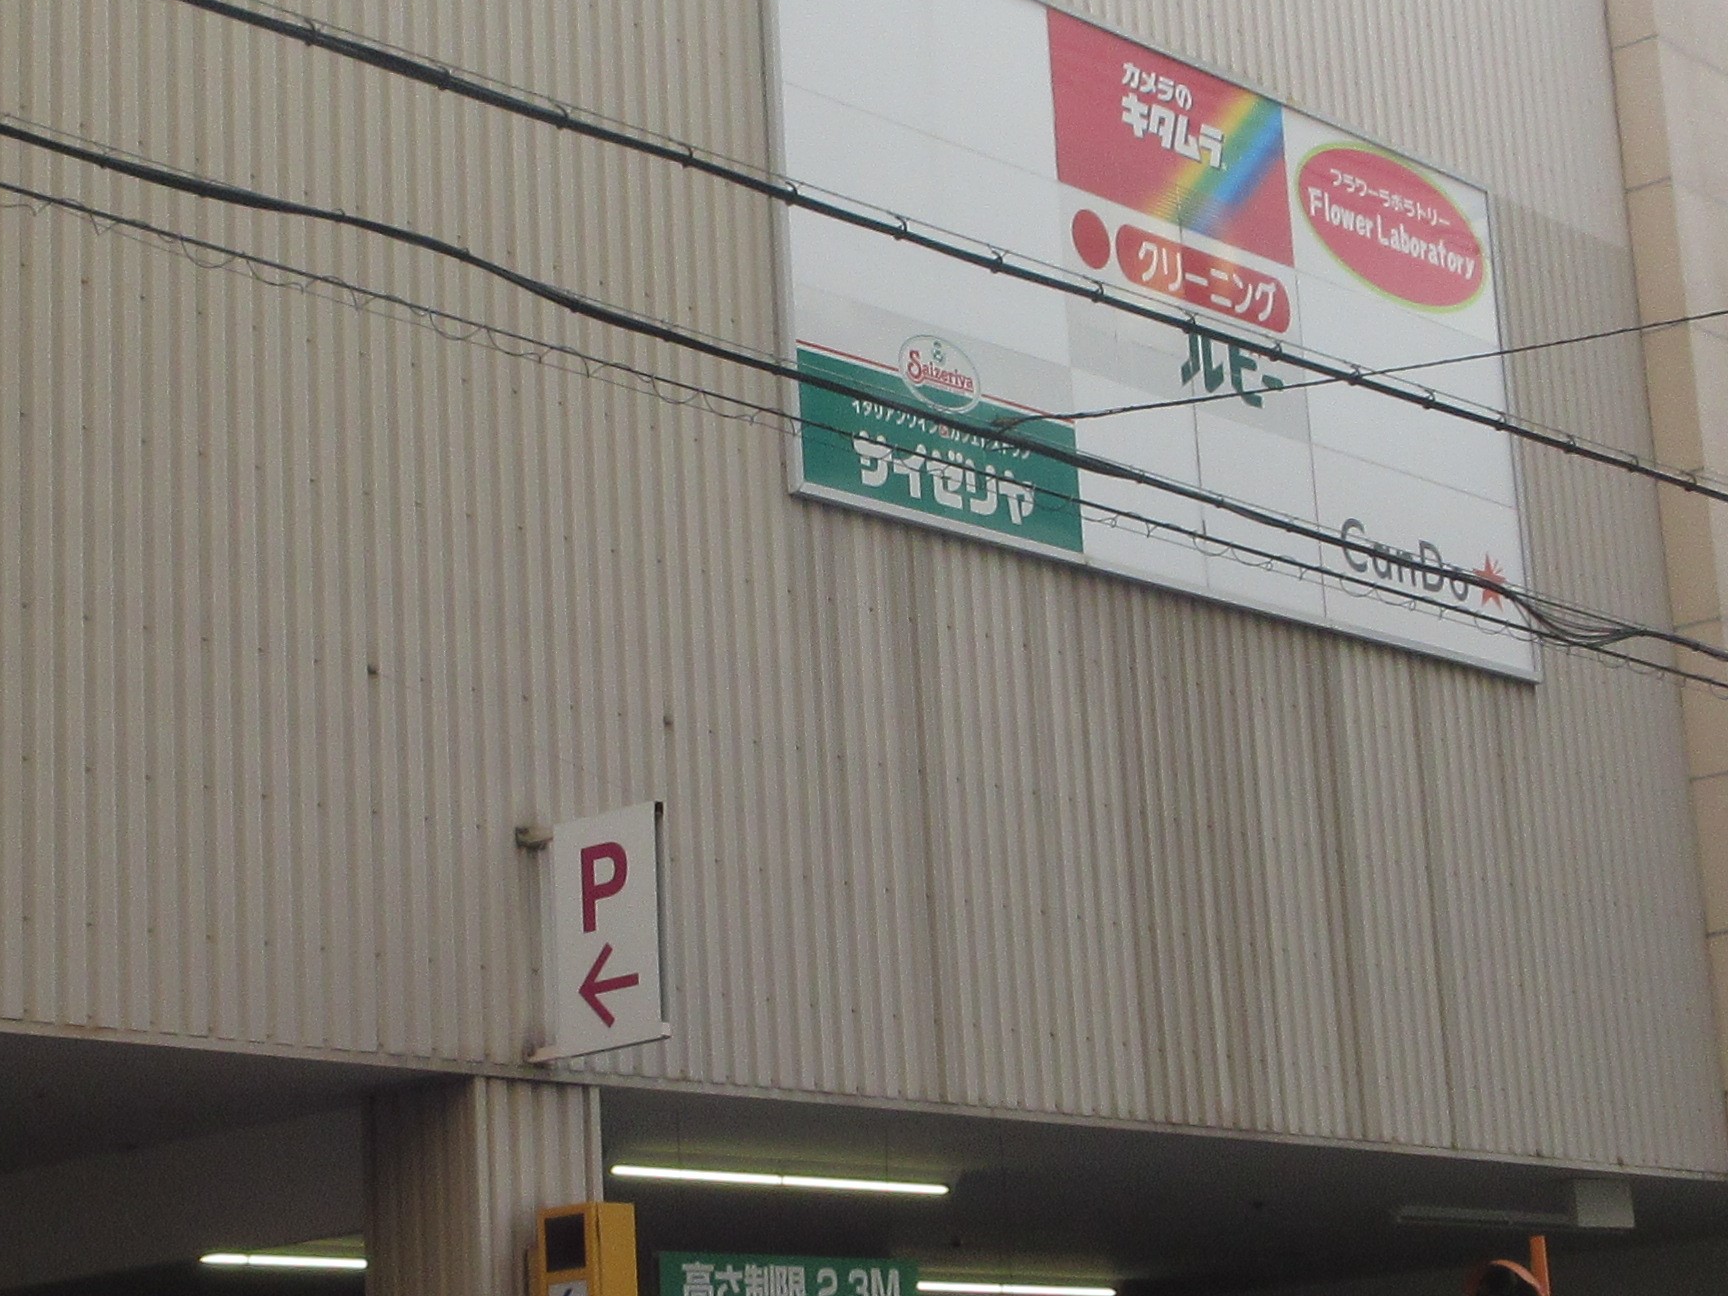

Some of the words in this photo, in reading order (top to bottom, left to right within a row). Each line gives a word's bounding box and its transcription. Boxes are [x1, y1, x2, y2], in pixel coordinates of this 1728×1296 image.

[1122, 62, 1193, 112] カメラの
[1121, 92, 1224, 169] キタムラ
[1308, 186, 1373, 239] Flower
[1377, 214, 1476, 280] Laboratory
[1137, 240, 1277, 322] クリーニング
[907, 349, 975, 391] Saizeriya
[852, 430, 1035, 526] サイゼリヤ
[579, 841, 629, 934] P
